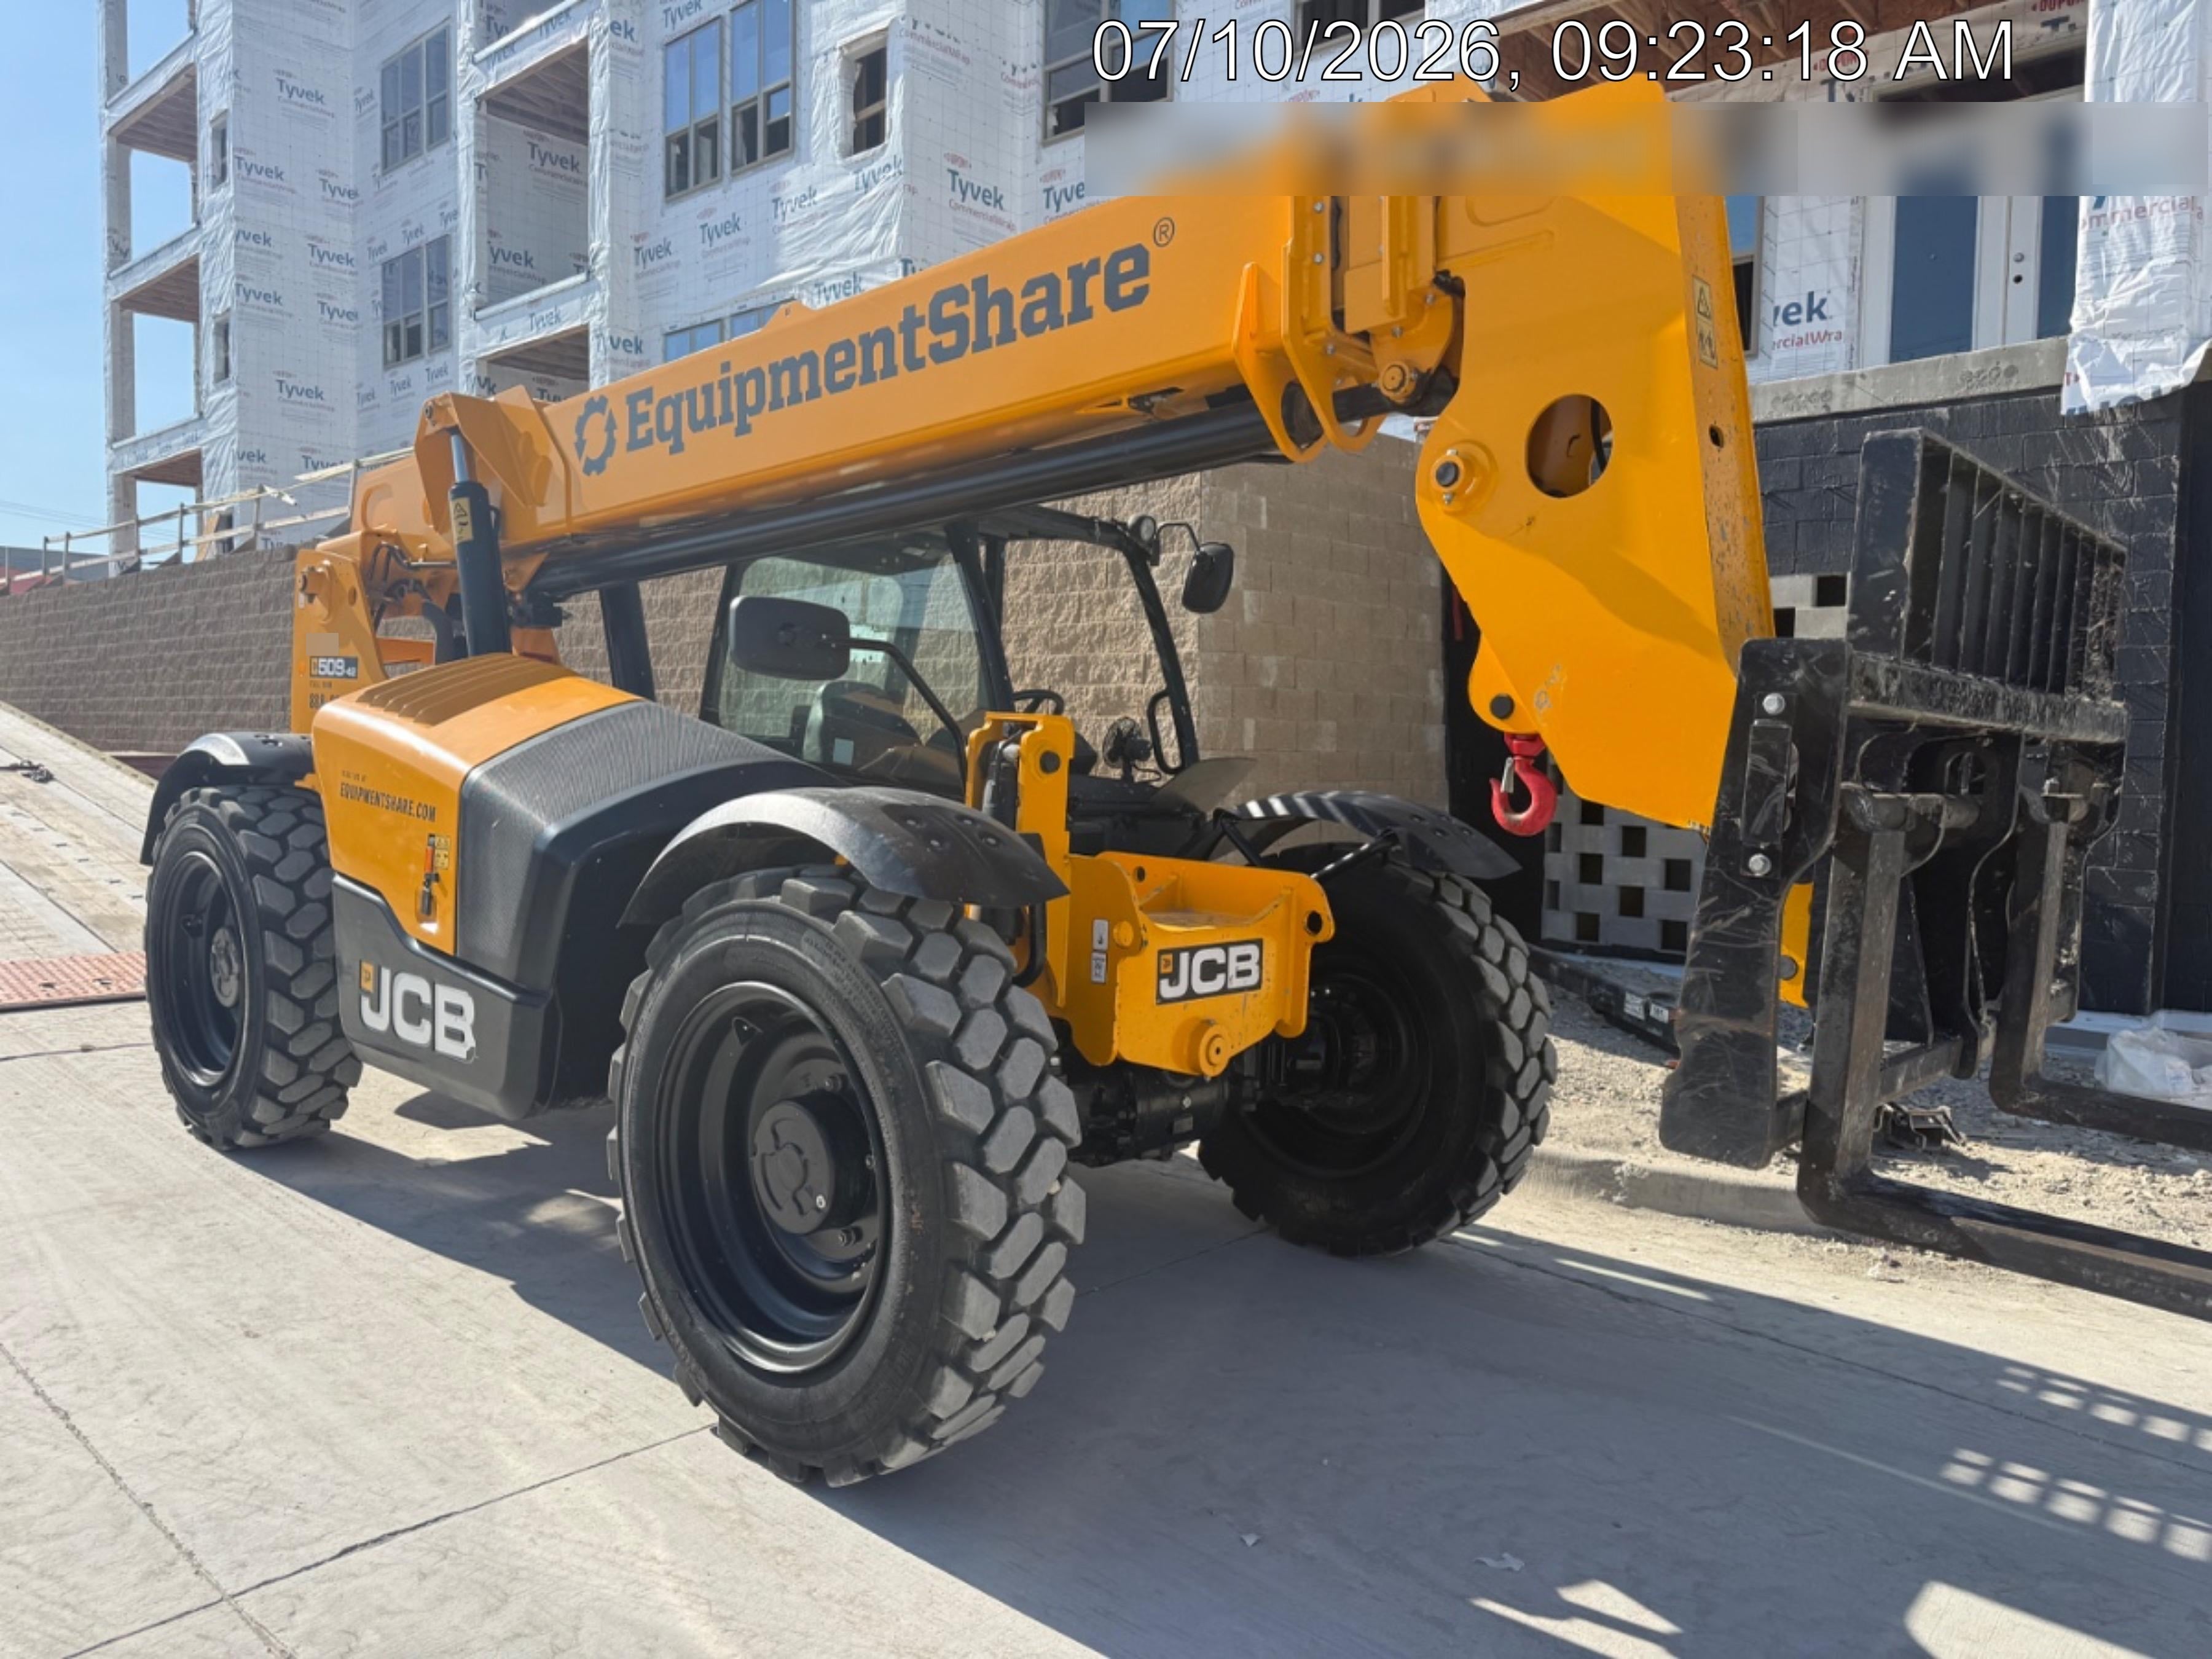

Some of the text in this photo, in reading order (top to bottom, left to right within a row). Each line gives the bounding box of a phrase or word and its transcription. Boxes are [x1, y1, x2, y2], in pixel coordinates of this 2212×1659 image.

[663, 0, 702, 31] Tyvek
[275, 77, 325, 104] Tyvek
[234, 155, 285, 181] Tyvek
[527, 141, 581, 173] Tyvek
[853, 155, 903, 195] Tyvek
[947, 168, 1004, 211] Tyvek
[772, 186, 817, 222] Tyvek
[1043, 181, 1084, 213] Tyve
[700, 211, 741, 247] Tyvek
[308, 243, 355, 267] Tyvek
[488, 243, 535, 269] yvek
[634, 237, 672, 269] Tyvek
[235, 283, 283, 306] Tyvek
[814, 272, 863, 304] Tyvek
[626, 243, 1150, 455] EquipmentShare
[276, 379, 325, 400] Tyvek
[340, 782, 436, 822] EQUIPMENTSHARE.COM
[1159, 944, 1260, 998] JCB
[361, 965, 476, 1061] JCB
